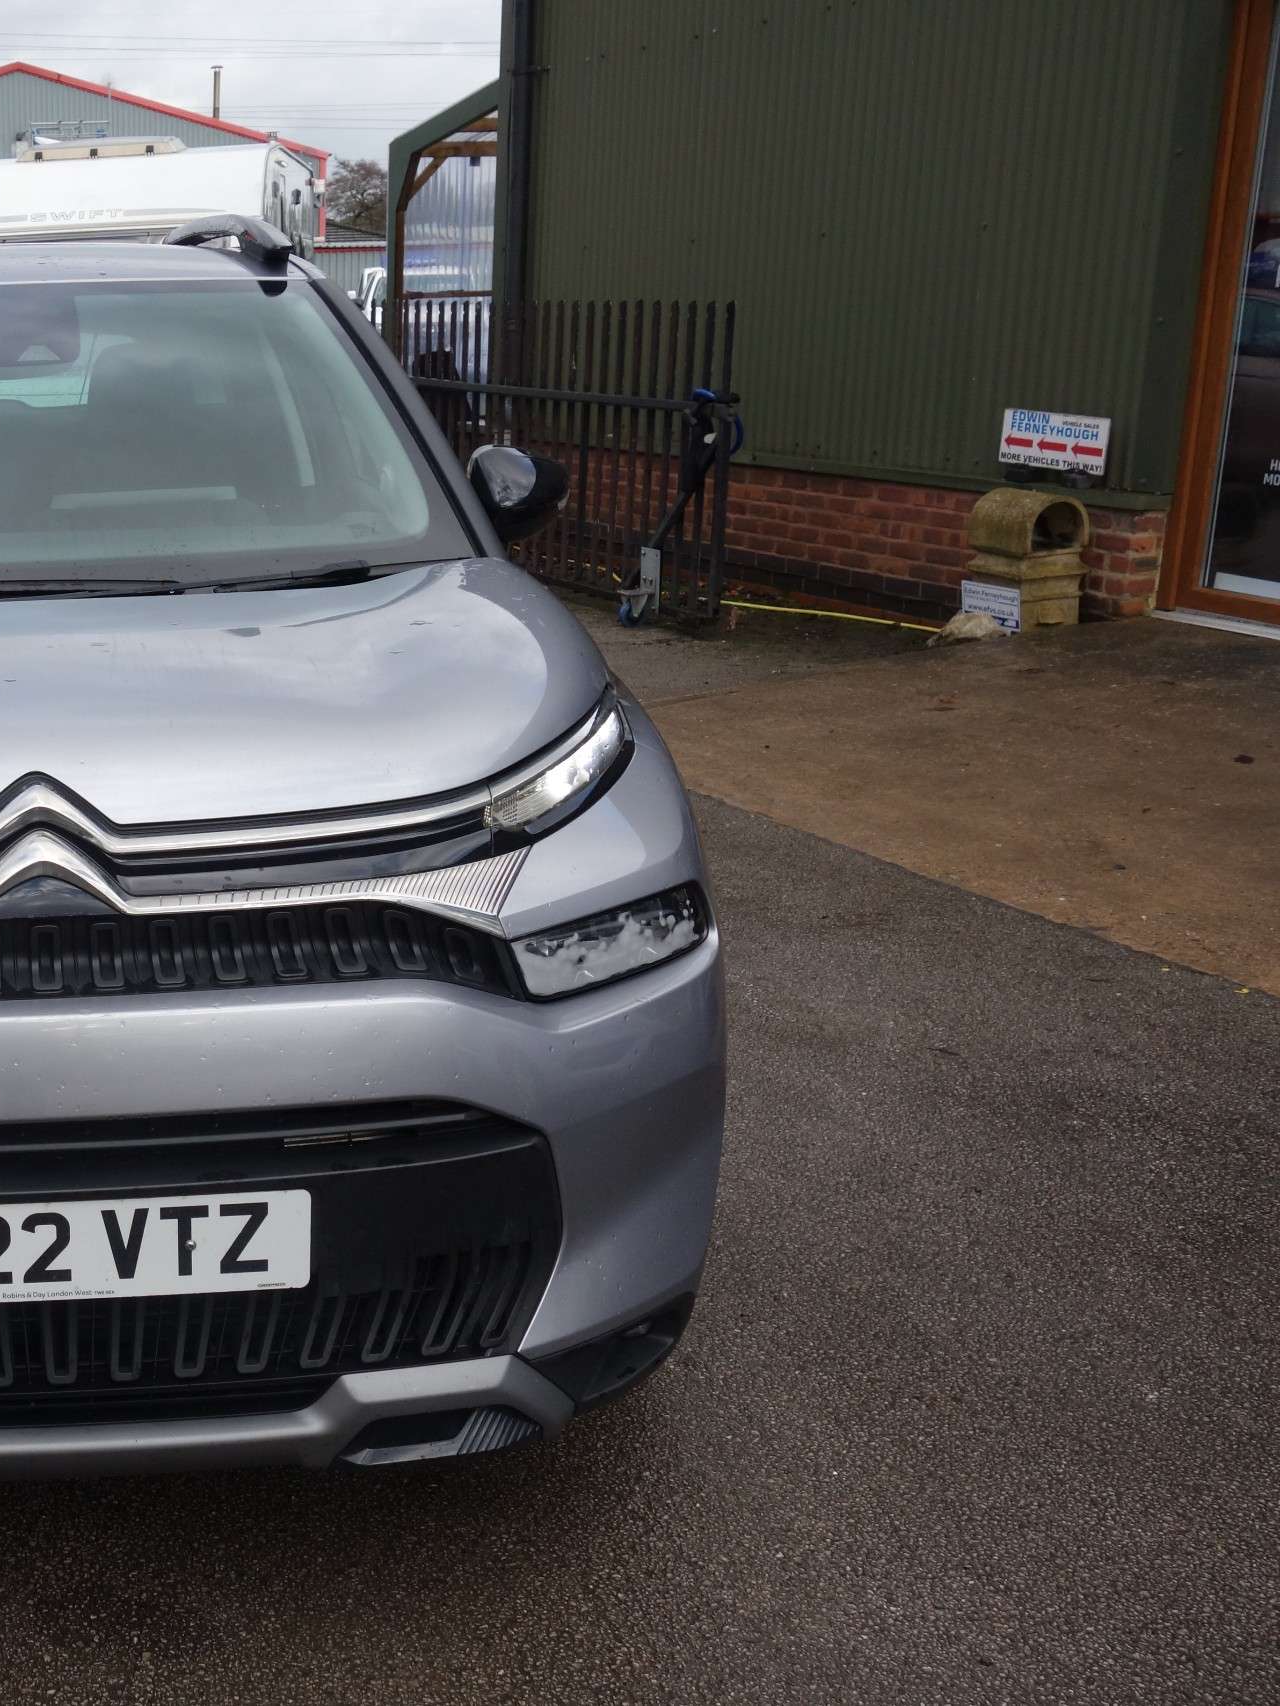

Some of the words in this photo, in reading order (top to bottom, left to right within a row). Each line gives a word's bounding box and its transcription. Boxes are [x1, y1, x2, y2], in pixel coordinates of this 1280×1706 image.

[31, 209, 123, 222] SWIFT
[1012, 410, 1051, 425] EDWIN
[1010, 421, 1099, 441] FERNEYHOUGH
[1000, 452, 1021, 461] MORE
[1023, 455, 1060, 467] VEHICLES
[1062, 460, 1080, 470] THIS
[1082, 463, 1104, 473] WAY!
[1270, 458, 1280, 471] H
[100, 1202, 269, 1280] VTZ
[32, 1291, 46, 1299] Day
